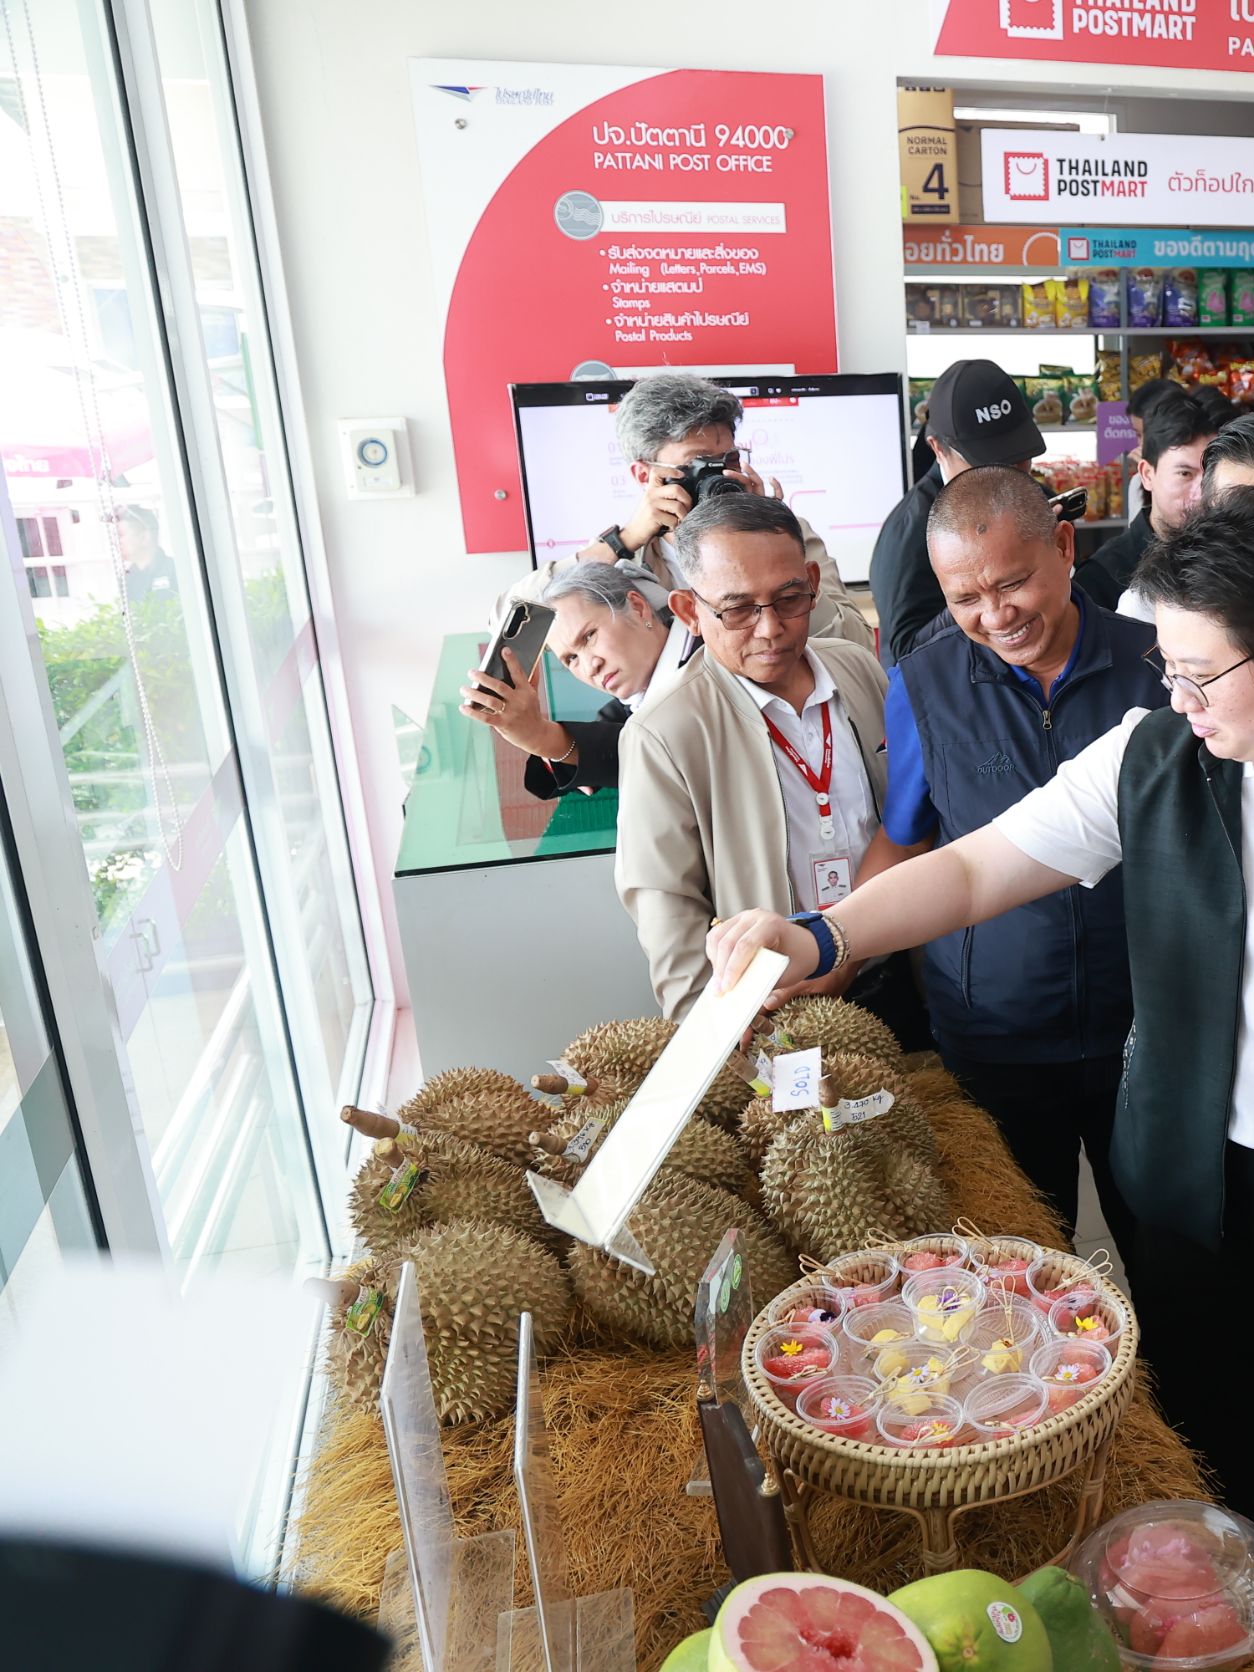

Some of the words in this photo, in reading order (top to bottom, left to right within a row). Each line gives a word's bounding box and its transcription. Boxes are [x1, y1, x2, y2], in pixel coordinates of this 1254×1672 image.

[1073, 8, 1197, 41] POSTMART
[592, 120, 706, 147] ปจ.ปัตตานี
[714, 124, 790, 150] 94000
[906, 136, 948, 146] NORMAL
[907, 146, 948, 156] CARTON
[593, 151, 664, 171] PATTANI
[669, 153, 711, 171] POST
[716, 155, 773, 173] OFFICE
[1056, 158, 1149, 178] THAILAND
[922, 162, 949, 200] 4
[1057, 178, 1148, 198] POSTMART
[707, 214, 740, 225] POSTAL
[743, 215, 781, 226] SERVICES
[1092, 239, 1138, 249] THAILAND
[1092, 249, 1137, 259] POSTMART
[609, 262, 650, 278] Mailing
[612, 296, 651, 312] Stamps
[615, 328, 647, 343] Postal
[650, 328, 694, 343] Products
[974, 398, 1013, 425] NSO
[790, 1065, 811, 1097] SOLD
